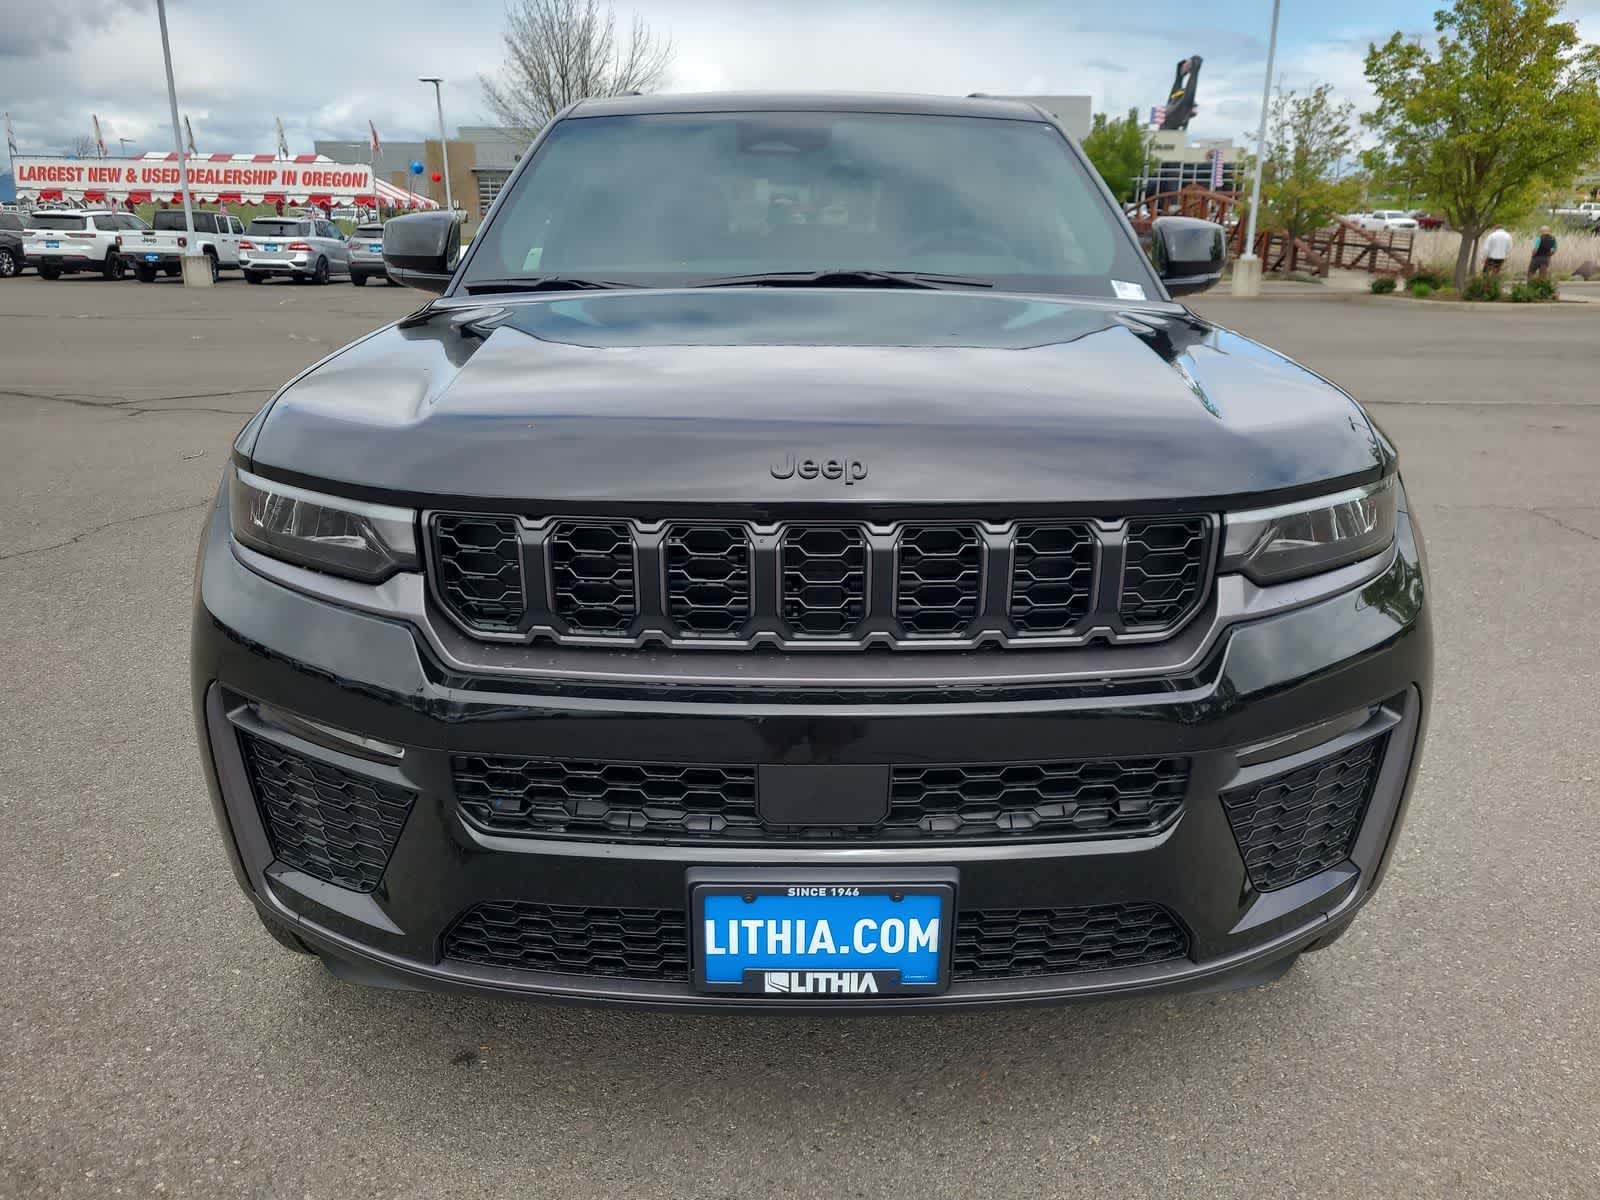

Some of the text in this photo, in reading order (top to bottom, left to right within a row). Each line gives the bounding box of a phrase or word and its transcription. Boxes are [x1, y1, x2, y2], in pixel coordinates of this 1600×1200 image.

[19, 166, 368, 188] LARGEST NEW & USED DEALERSHIP IN OREGON!
[769, 452, 868, 485] Jeep
[787, 887, 860, 897] SINCE 1946
[705, 918, 939, 955] LITHIA.COM
[790, 972, 879, 993] LITHIA
